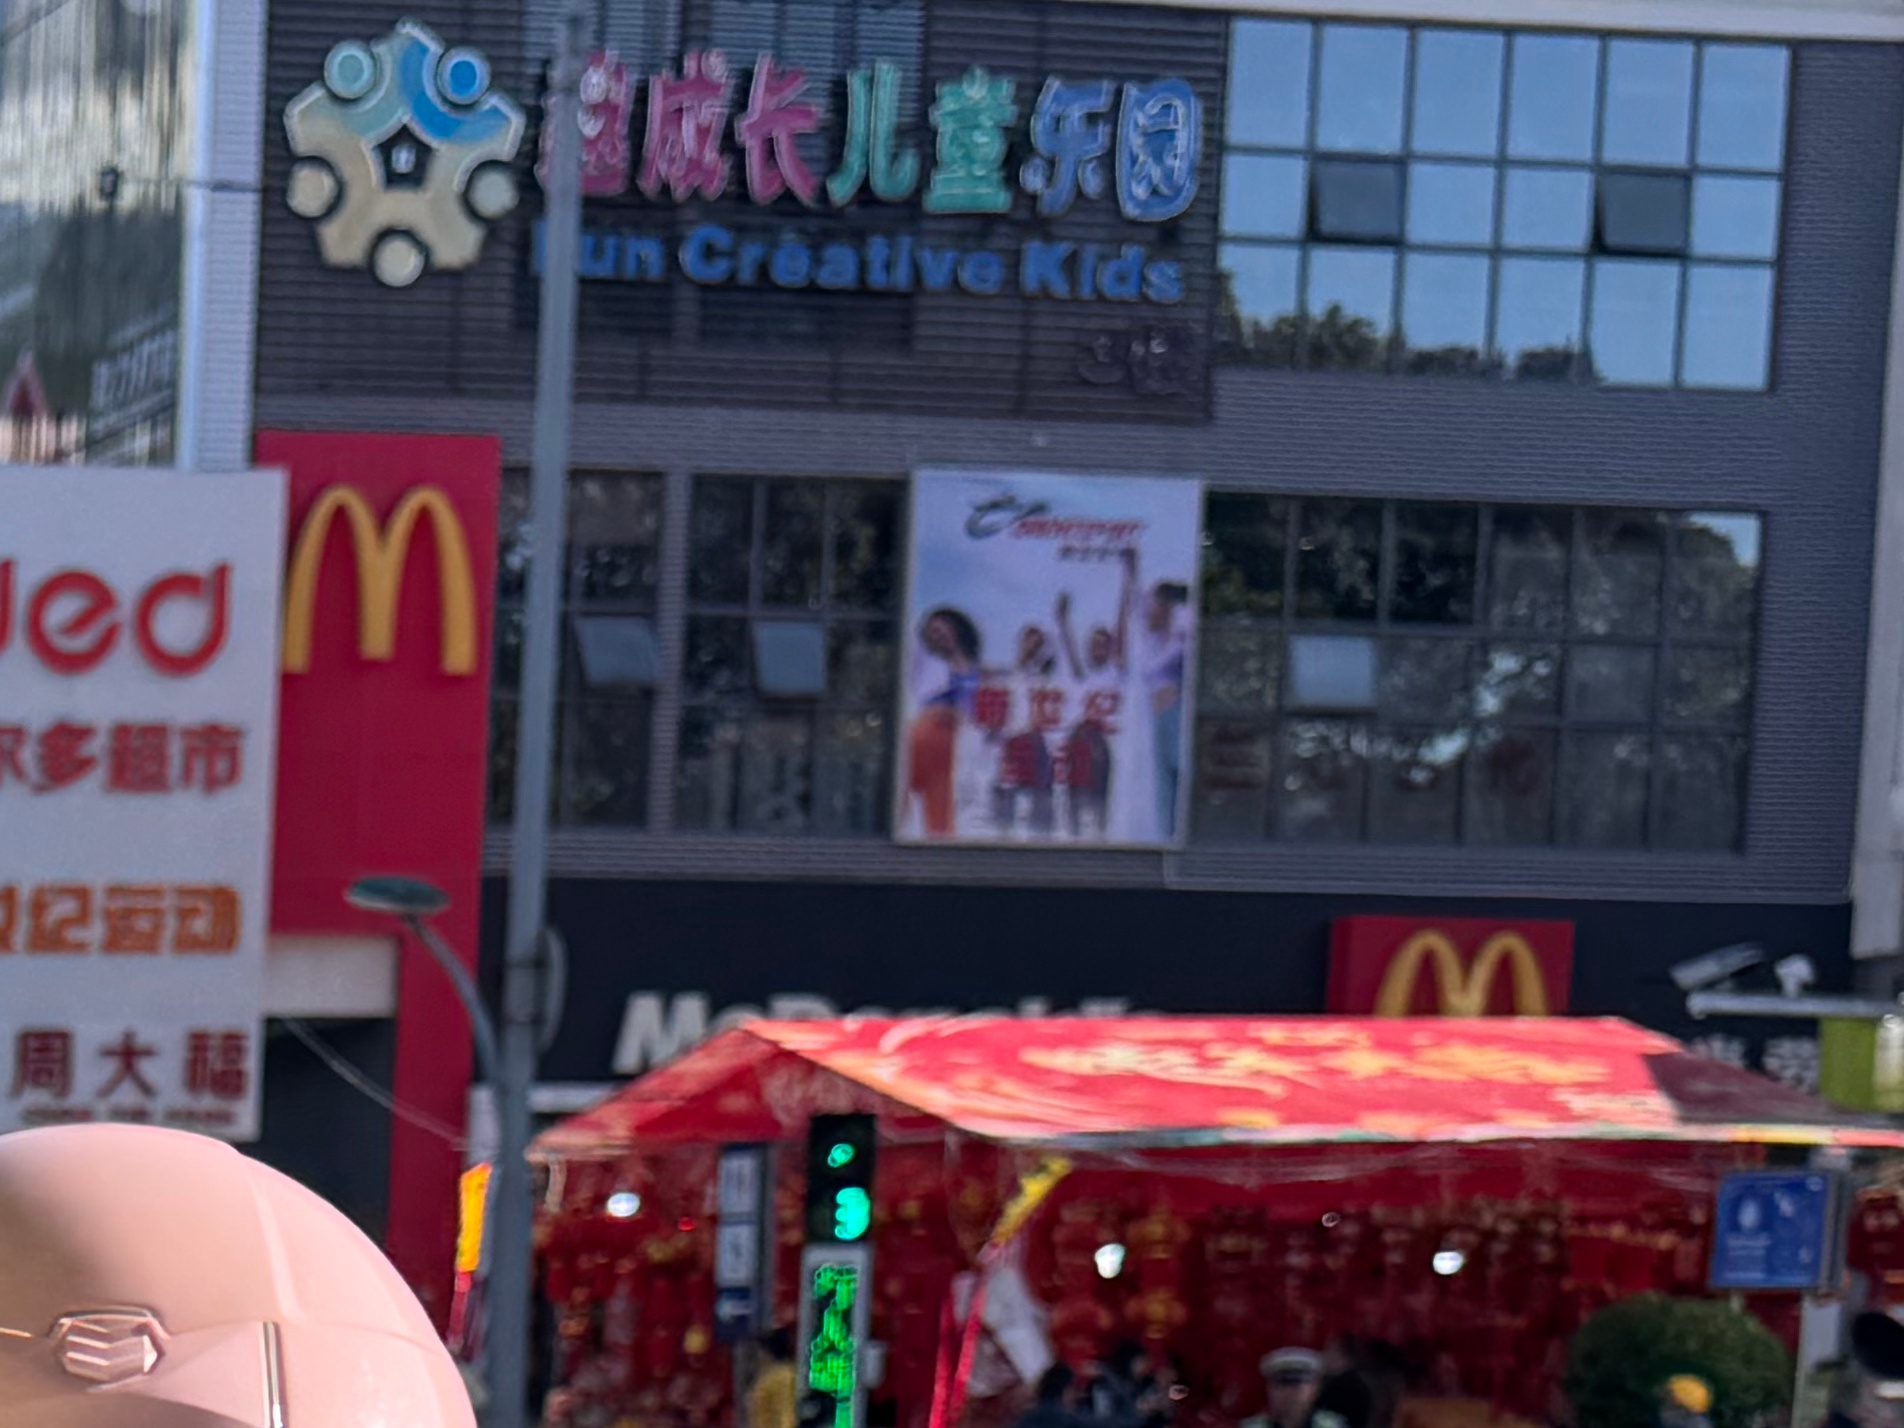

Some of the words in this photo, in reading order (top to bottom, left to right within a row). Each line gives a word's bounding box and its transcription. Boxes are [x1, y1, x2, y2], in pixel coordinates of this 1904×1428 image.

[678, 223, 1005, 298] Creative
[1019, 239, 1188, 306] Kids
[9, 1026, 252, 1102] 周大福
